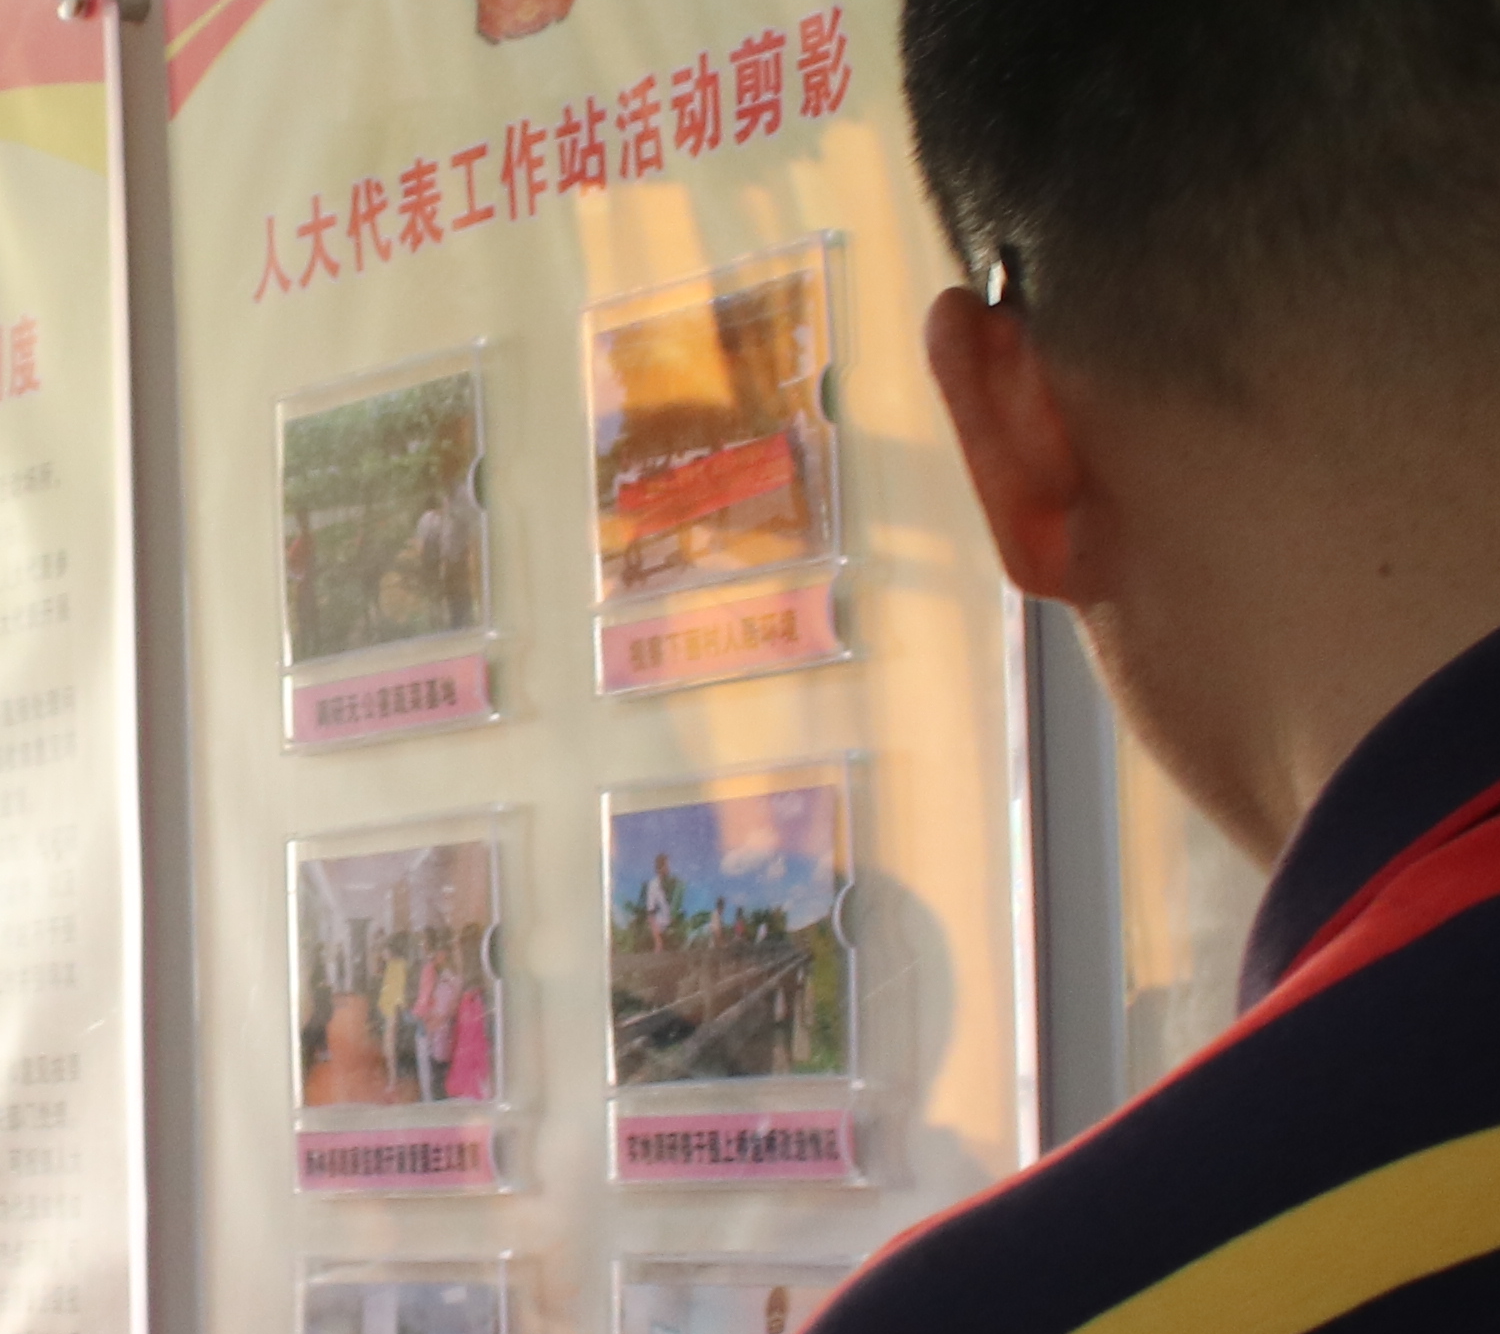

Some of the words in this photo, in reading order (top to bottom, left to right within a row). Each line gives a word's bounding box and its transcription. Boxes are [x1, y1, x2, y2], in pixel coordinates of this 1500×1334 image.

[253, 4, 853, 303] 人大代表工作站活动剪影
